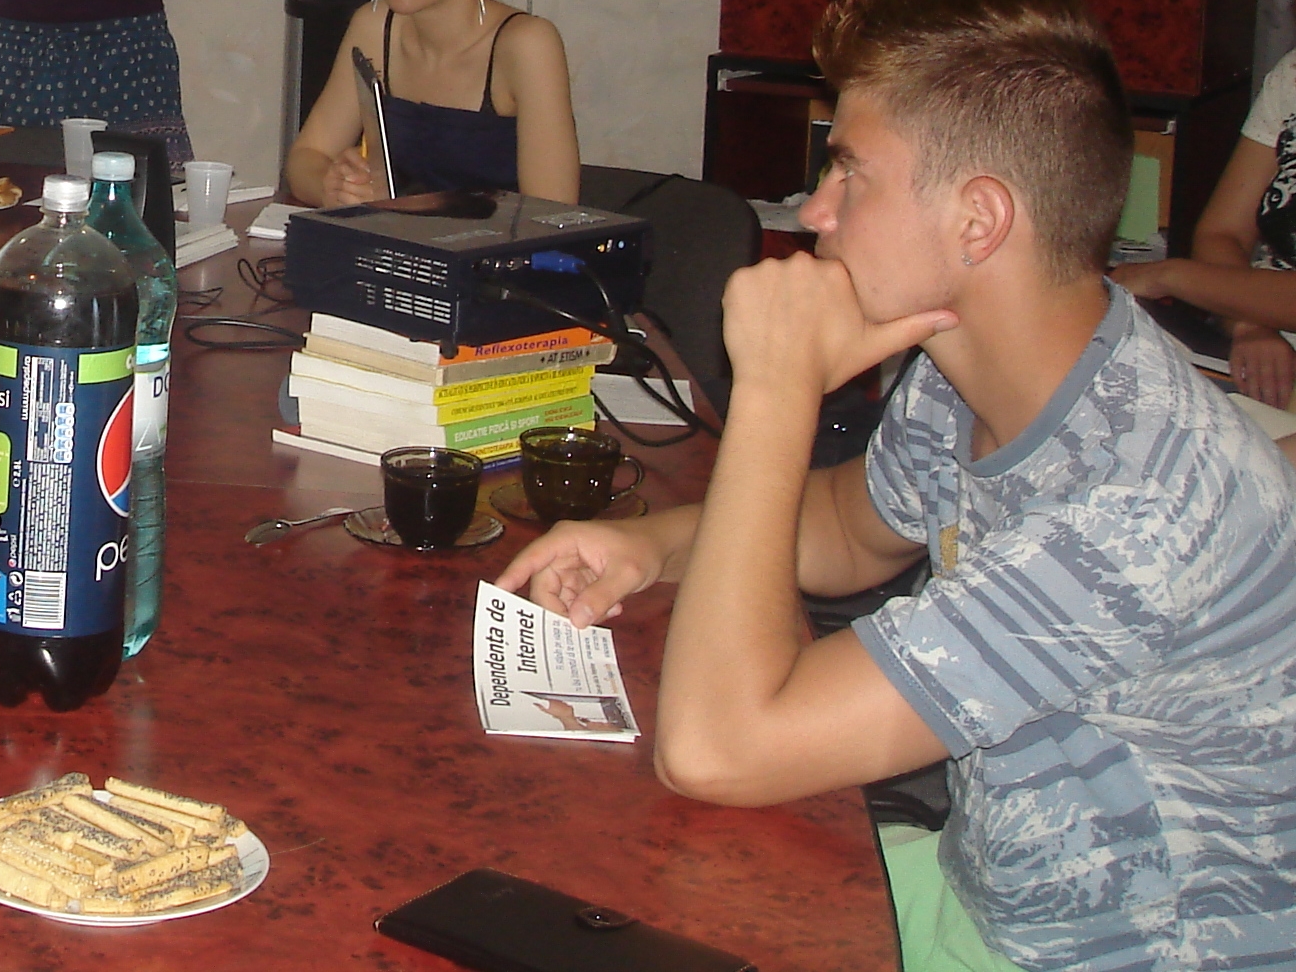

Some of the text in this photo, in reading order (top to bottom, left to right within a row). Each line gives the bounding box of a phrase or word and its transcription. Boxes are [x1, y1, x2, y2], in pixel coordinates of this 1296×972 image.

[474, 335, 568, 357] Reflexoterapia
[485, 598, 506, 623] de
[516, 608, 538, 674] Internet
